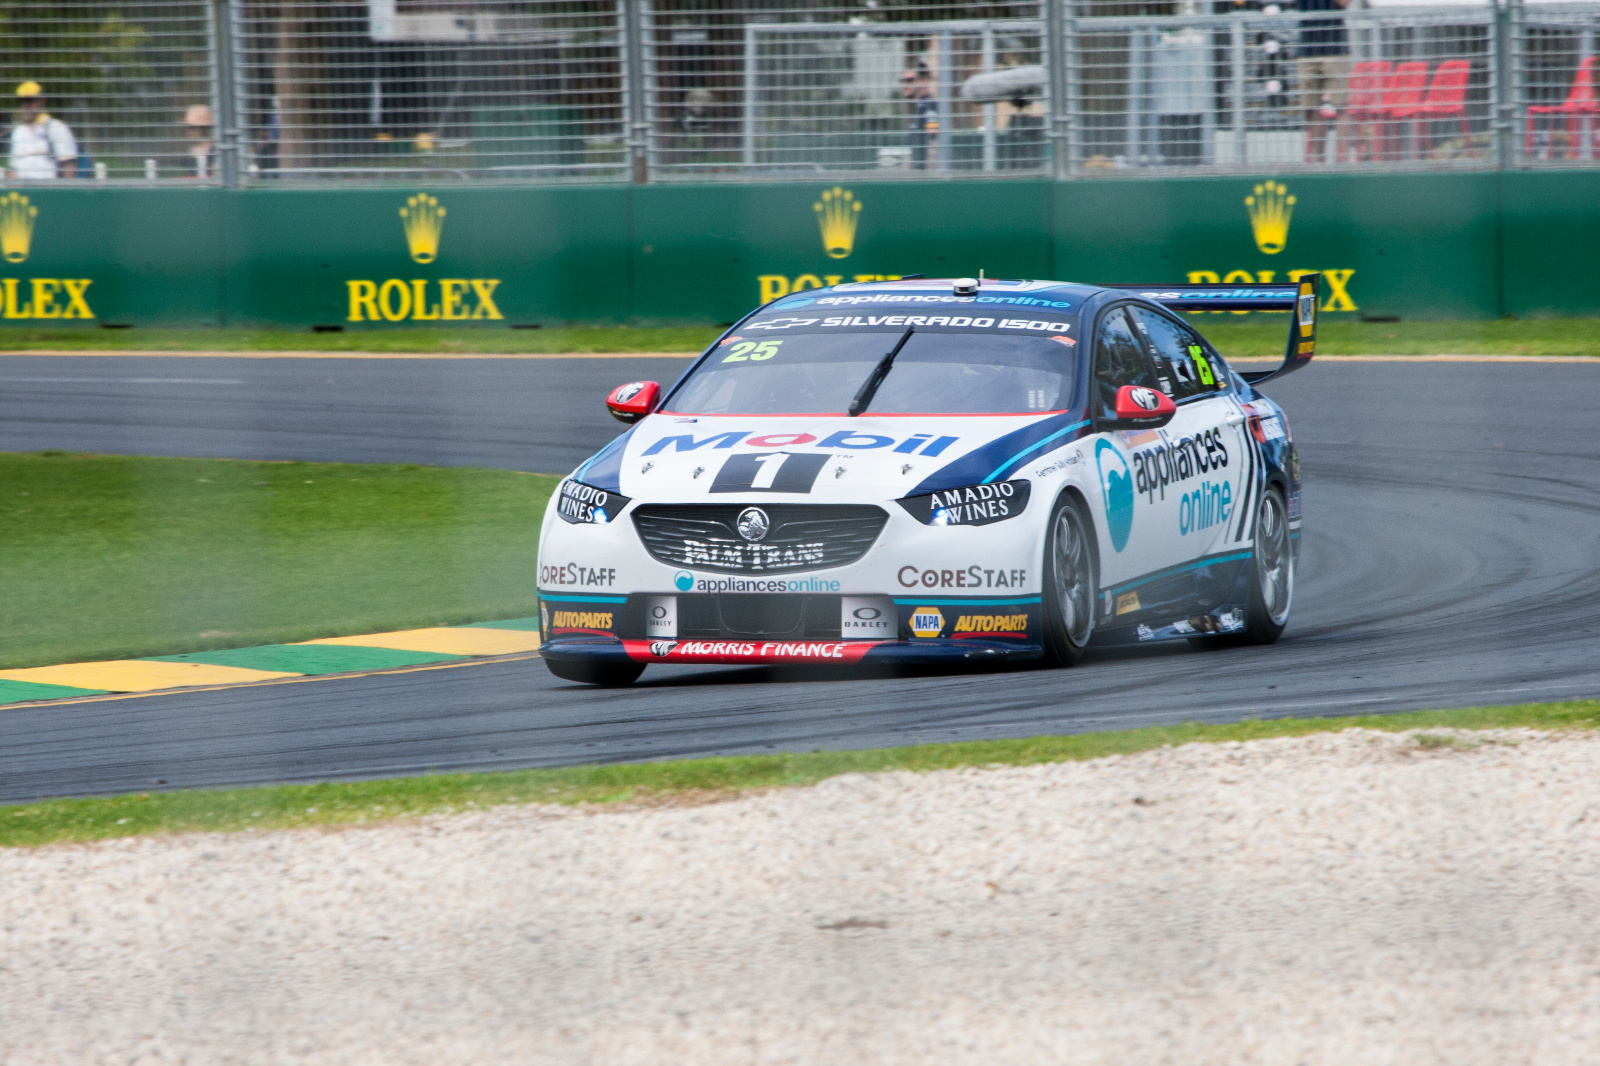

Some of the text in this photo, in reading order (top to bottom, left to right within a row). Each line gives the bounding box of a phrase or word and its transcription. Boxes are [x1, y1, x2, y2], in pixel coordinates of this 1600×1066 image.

[0, 277, 96, 319] LEX
[345, 278, 504, 321] ROLEX
[819, 315, 1071, 332] SILVERADO 1500
[721, 340, 783, 363] 25
[640, 430, 960, 457] Mobil
[752, 452, 791, 489] 1
[1132, 426, 1229, 505] appliances
[931, 482, 1014, 509] AMADIO
[1179, 480, 1232, 536] online
[945, 499, 1009, 524] WINES
[915, 615, 940, 630] NAPA
[680, 641, 847, 658] MORRIS FINANCE
